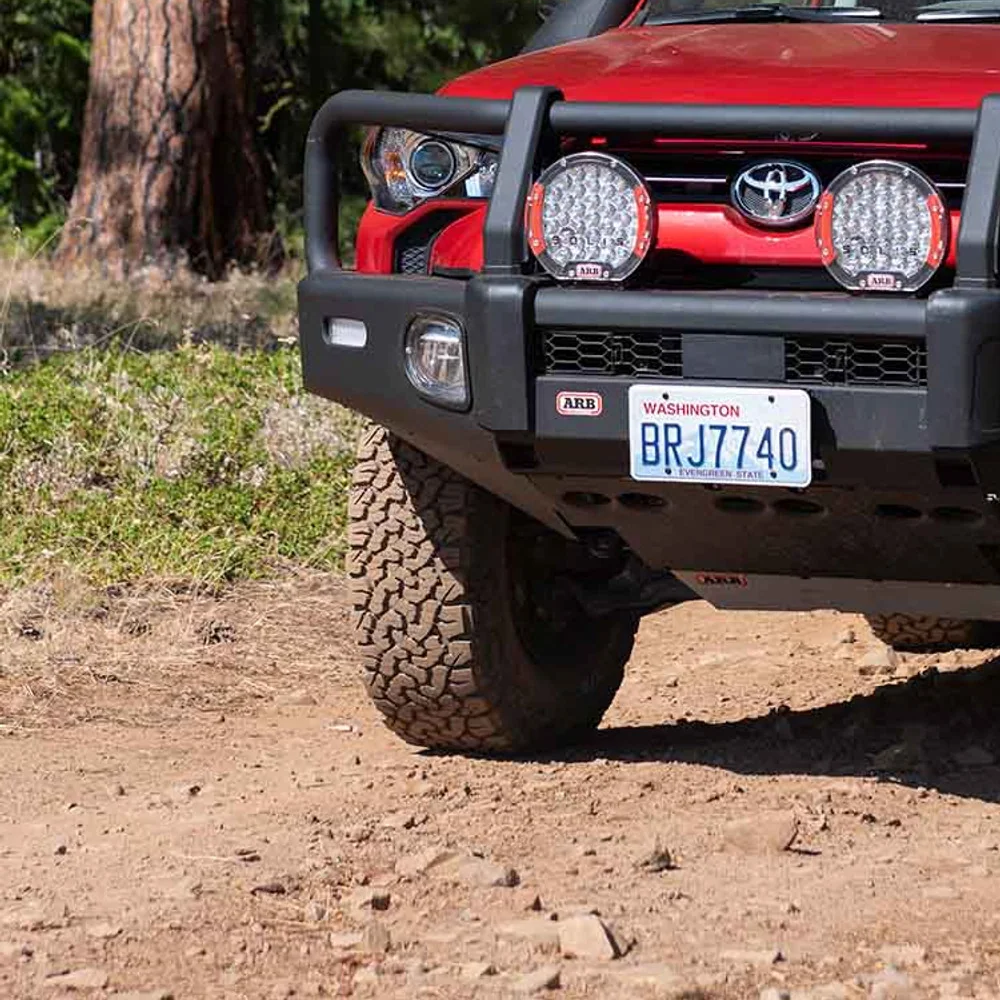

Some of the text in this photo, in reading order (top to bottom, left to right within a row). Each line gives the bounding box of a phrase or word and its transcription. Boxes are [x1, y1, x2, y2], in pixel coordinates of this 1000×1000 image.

[563, 397, 596, 410] ARB
[643, 402, 741, 418] WASHINGTON
[641, 422, 798, 471] BRJ7740
[679, 468, 765, 479] EVERGREEN STATE
